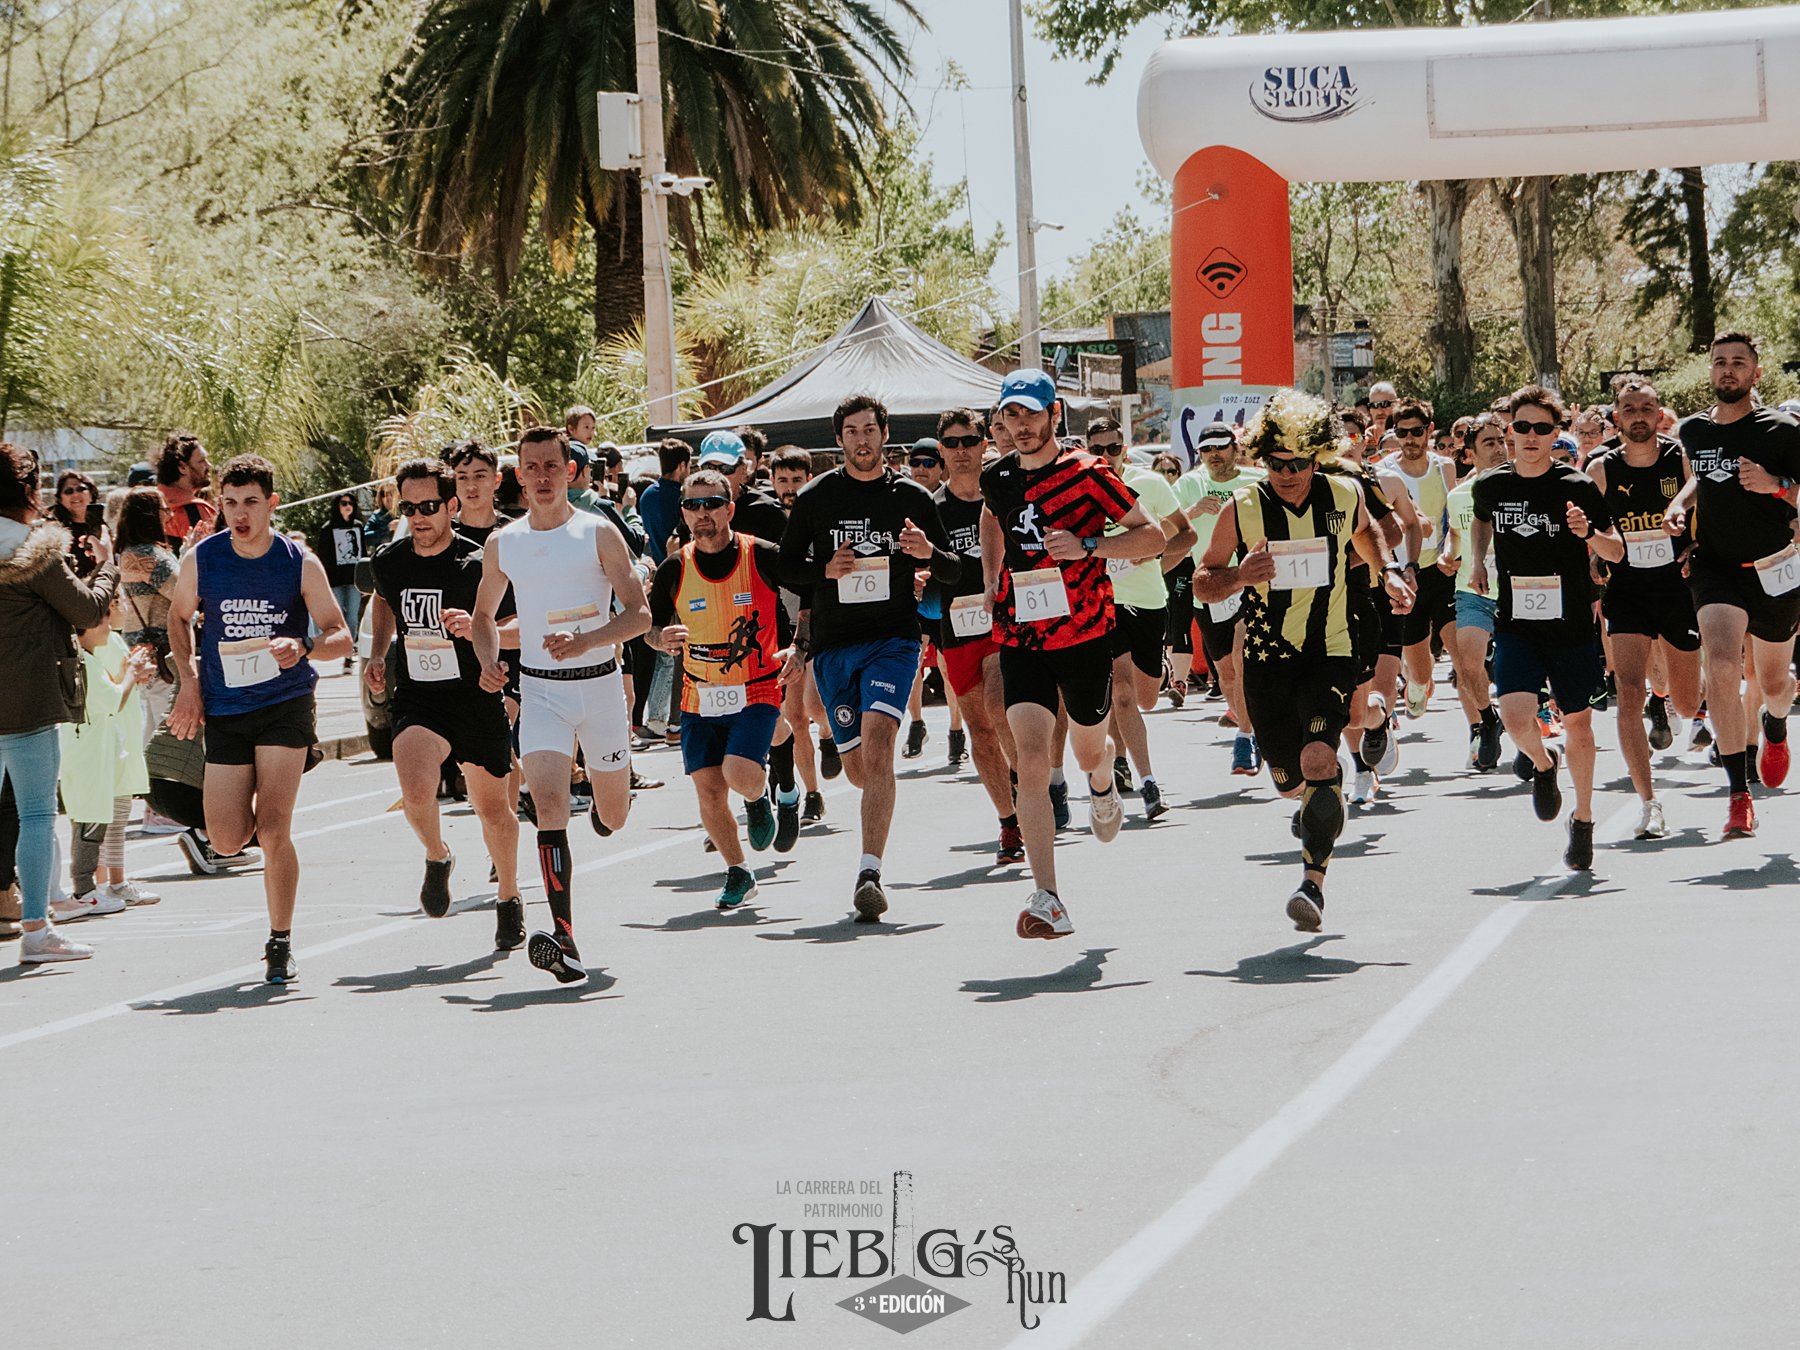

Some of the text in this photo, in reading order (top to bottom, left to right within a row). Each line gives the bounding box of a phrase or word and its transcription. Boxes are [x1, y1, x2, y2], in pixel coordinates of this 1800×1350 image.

[1264, 66, 1351, 91] SUCA
[1263, 89, 1357, 108] SPORTS
[1635, 543, 1666, 560] 176
[1288, 557, 1309, 578] 11
[1772, 563, 1794, 584] 70
[852, 574, 876, 592] 76
[220, 599, 275, 613] GUALE-
[1026, 588, 1049, 610] 61
[1524, 593, 1547, 610] 52
[222, 610, 288, 625] GUAYCHÚ
[957, 610, 989, 628] 179
[224, 625, 276, 638] CORRE.
[235, 655, 259, 676] 77
[419, 653, 442, 671] 69
[706, 690, 739, 708] 189
